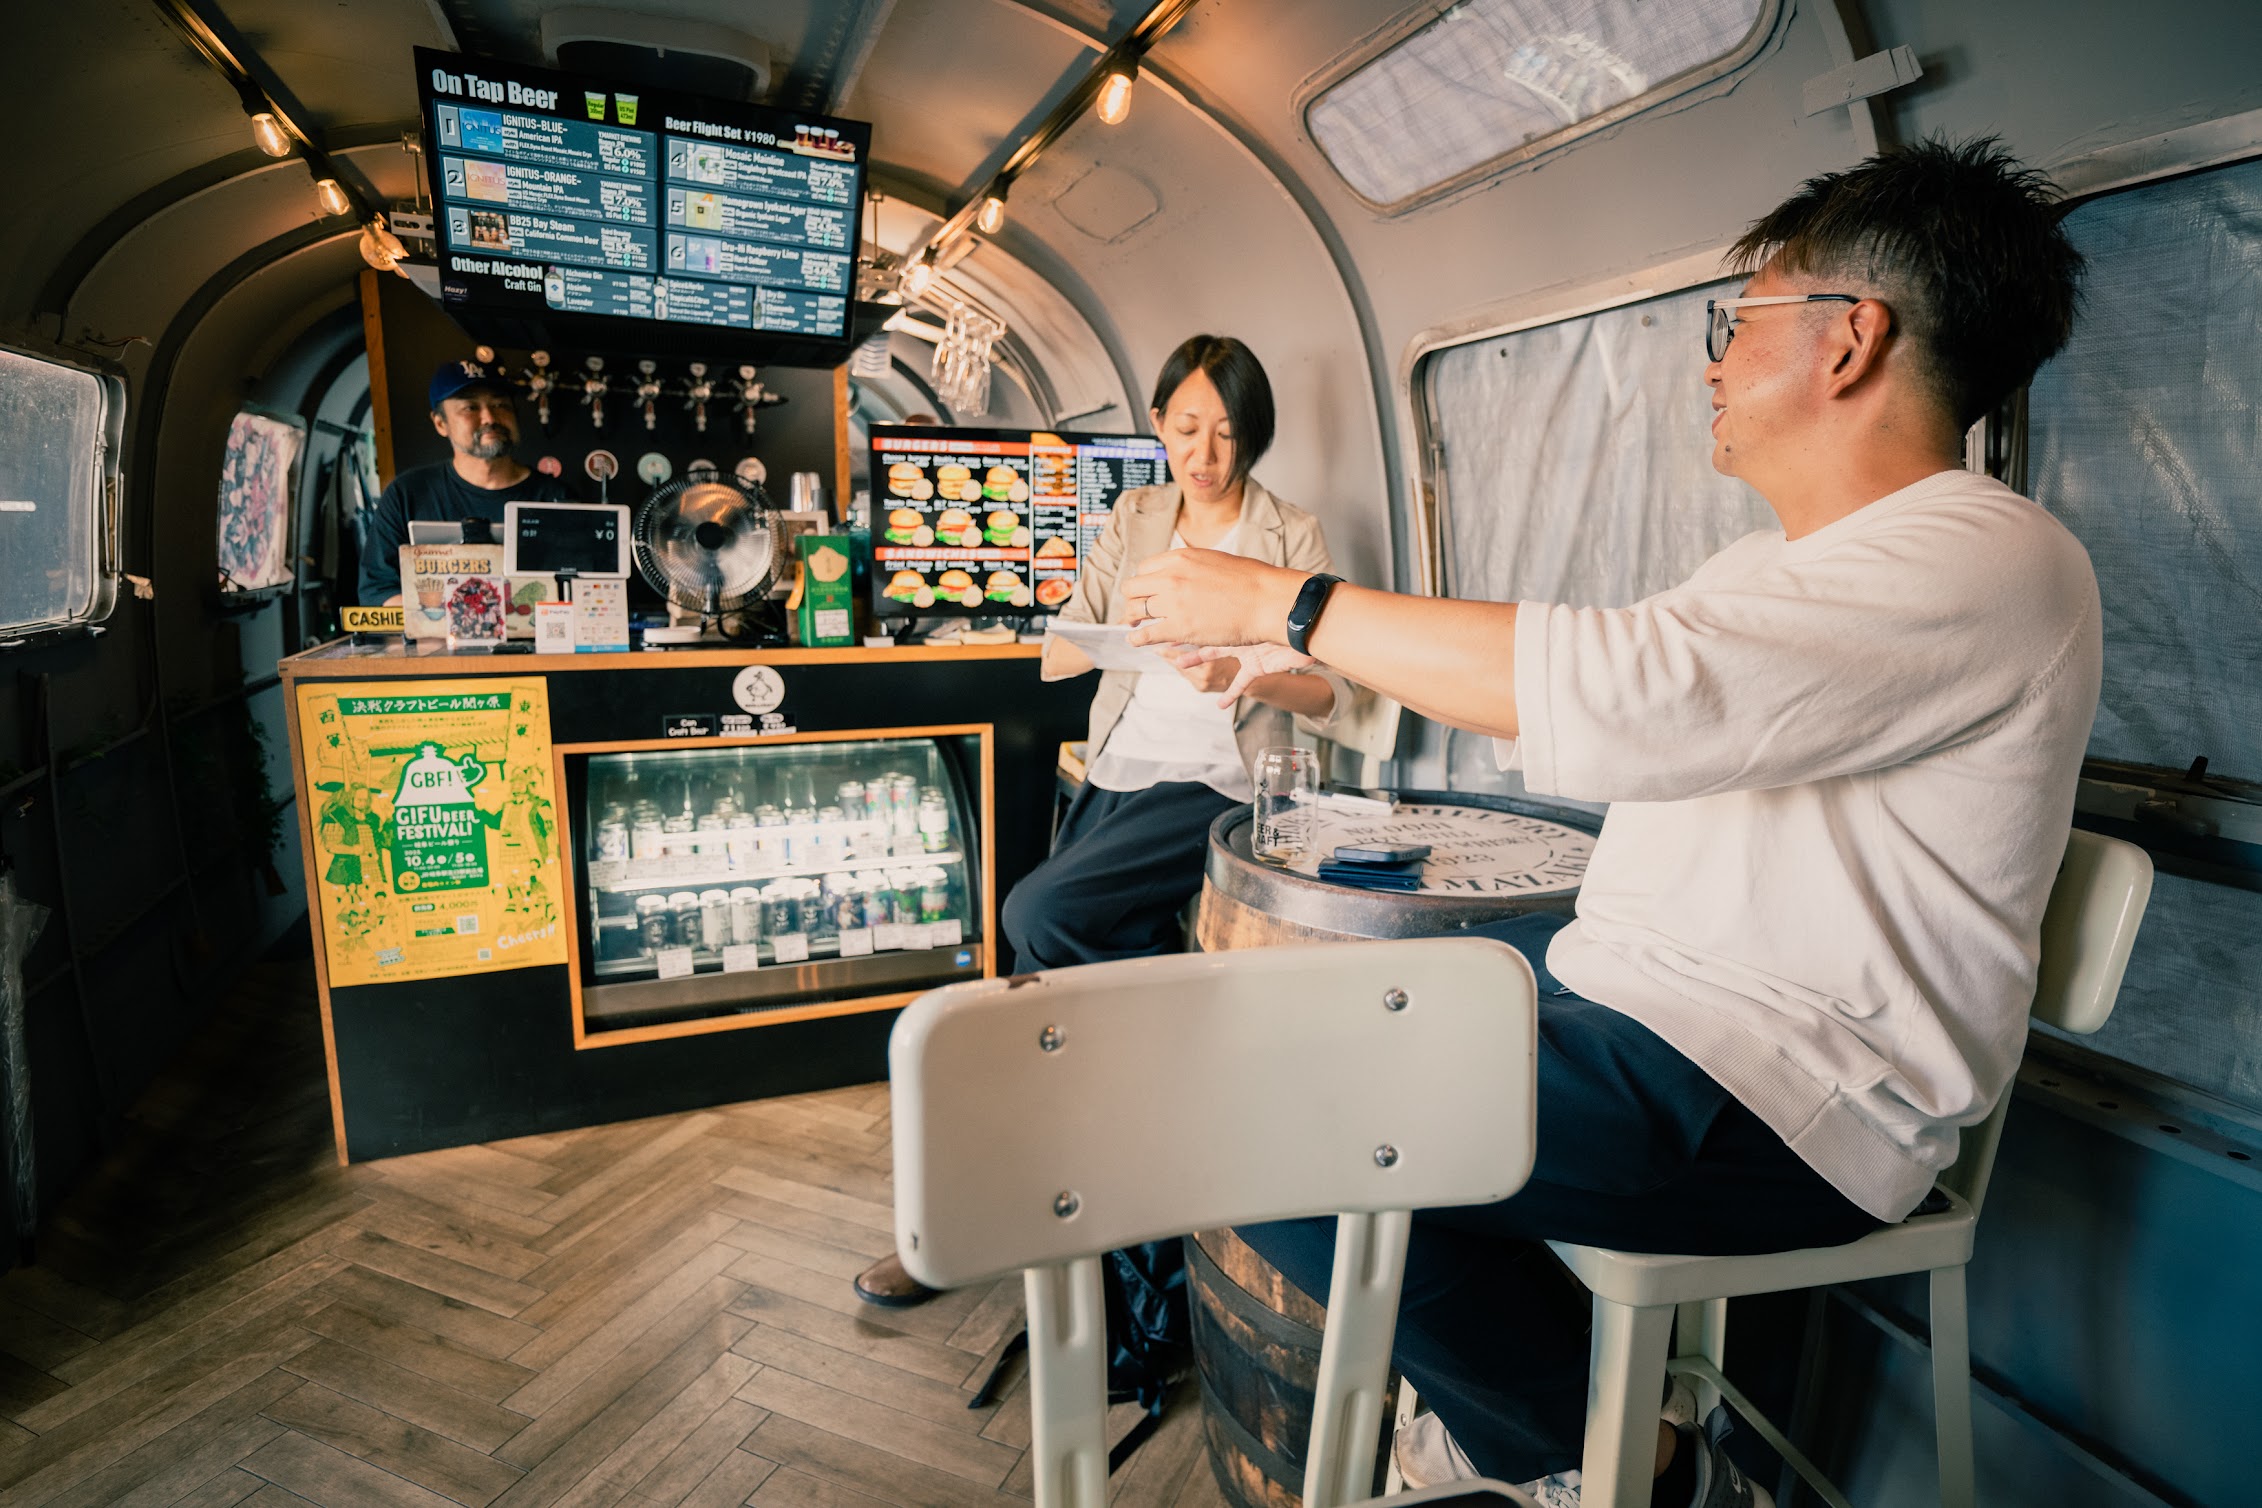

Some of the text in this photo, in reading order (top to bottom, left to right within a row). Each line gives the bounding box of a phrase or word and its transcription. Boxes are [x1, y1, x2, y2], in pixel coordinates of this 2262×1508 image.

[432, 69, 558, 111] On Tap Beer
[445, 118, 456, 136] 1
[665, 116, 776, 146] Beer Flight Set ¥1980
[519, 130, 550, 143] American
[551, 135, 563, 145] IPA
[614, 148, 641, 159] 6.0%
[671, 152, 687, 169] 4
[725, 147, 752, 162] Mosaic
[447, 169, 465, 187] 2
[522, 180, 552, 193] Mountain
[553, 184, 564, 194] IPA
[671, 200, 685, 216] 5
[453, 219, 468, 236] 3
[510, 215, 575, 233] BB25 Bay Steam
[524, 228, 556, 240] California
[556, 233, 583, 244] Common
[670, 245, 686, 261] 6
[451, 256, 490, 275] Other
[491, 260, 543, 280] Alcohol
[504, 278, 542, 293] Craft Gin
[460, 360, 486, 378] LA
[882, 439, 948, 452] BURGERS
[884, 547, 977, 560] SANDWICHES
[414, 559, 491, 574] BURGERS
[349, 612, 404, 626] CASHIE
[690, 726, 709, 736] Beer
[410, 769, 453, 789] GBF!
[396, 806, 481, 826] GIFU BEER
[1272, 828, 1280, 837] &
